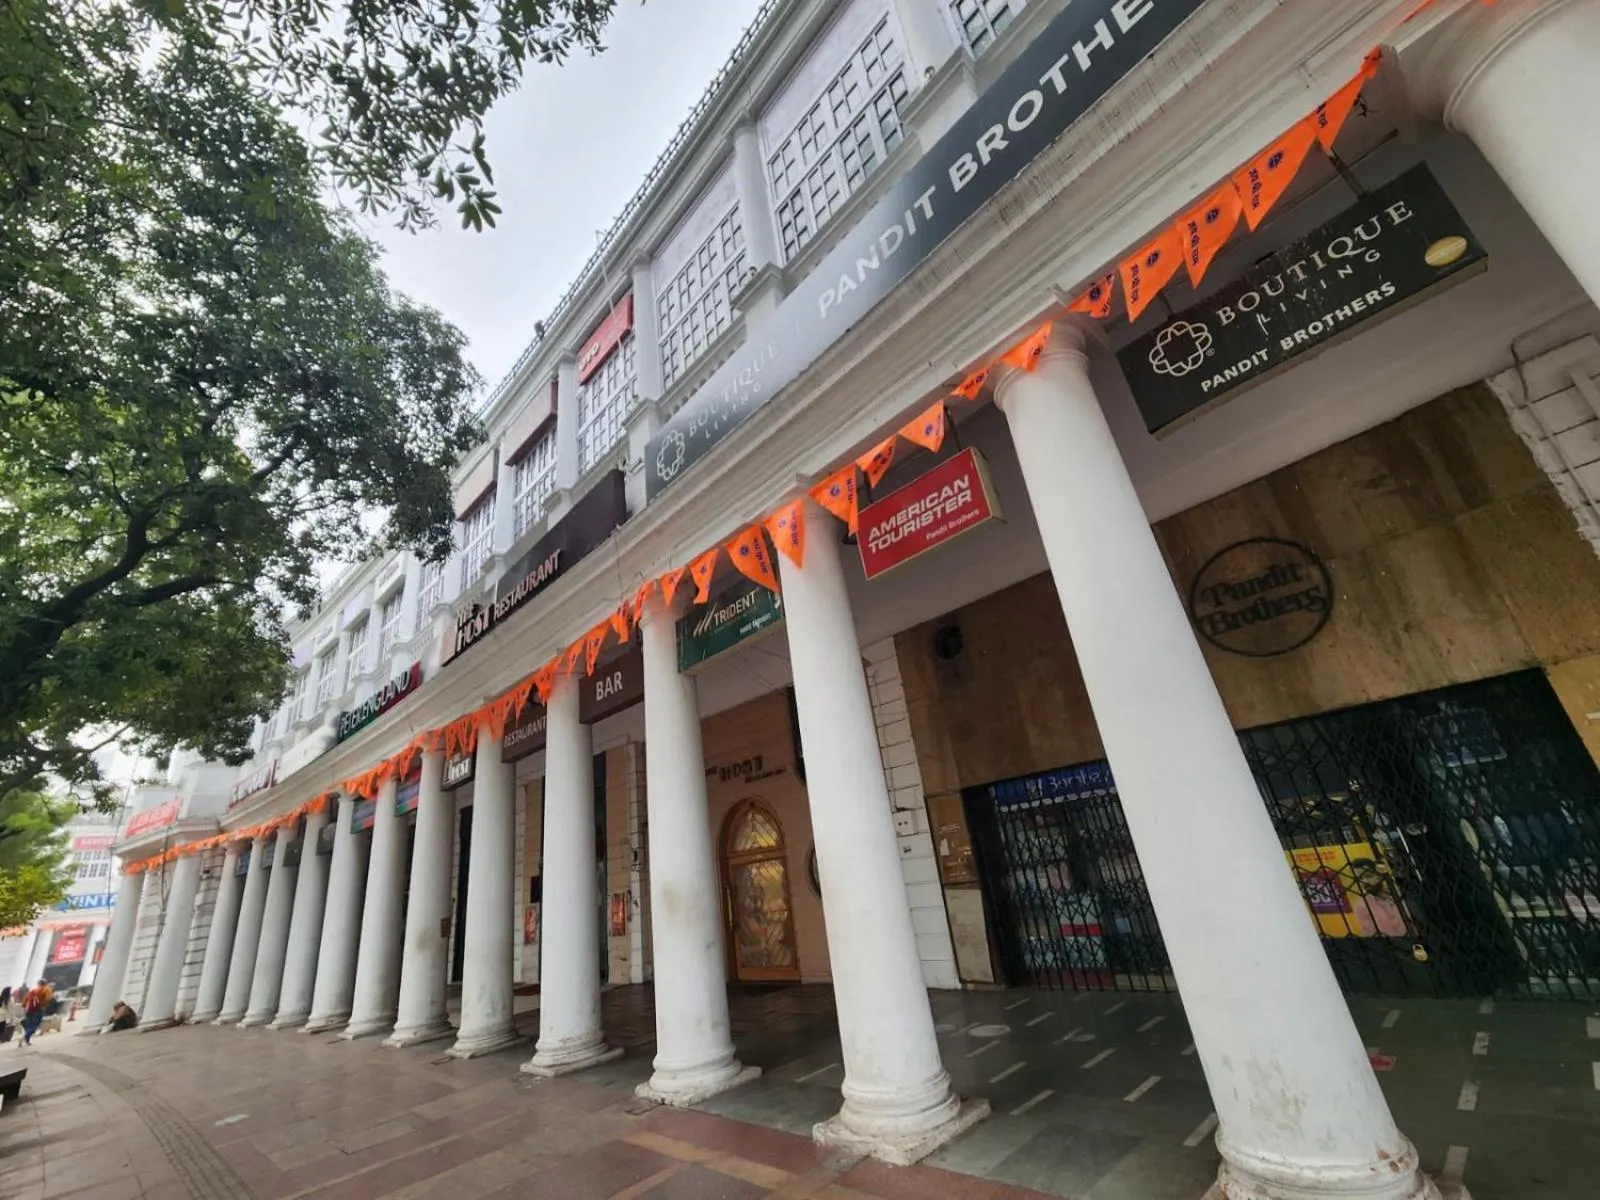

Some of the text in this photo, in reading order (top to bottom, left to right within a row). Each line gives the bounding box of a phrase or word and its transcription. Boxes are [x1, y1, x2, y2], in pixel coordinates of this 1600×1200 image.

[818, 186, 936, 319] PANDIT
[1216, 201, 1412, 326] BOUTIQUE
[1261, 249, 1380, 323] LIVING
[1200, 281, 1396, 392] PANDIT BROTHERS
[689, 341, 778, 438] BOUTIQUE
[706, 380, 762, 438] LIVING
[868, 473, 970, 542] AMERICAN
[868, 489, 972, 554] TOURISTER
[456, 548, 560, 652] HOST RESTAURANT
[714, 590, 756, 627] TRIDENT
[595, 671, 624, 701] BAR
[503, 715, 547, 748] RESTAURANT
